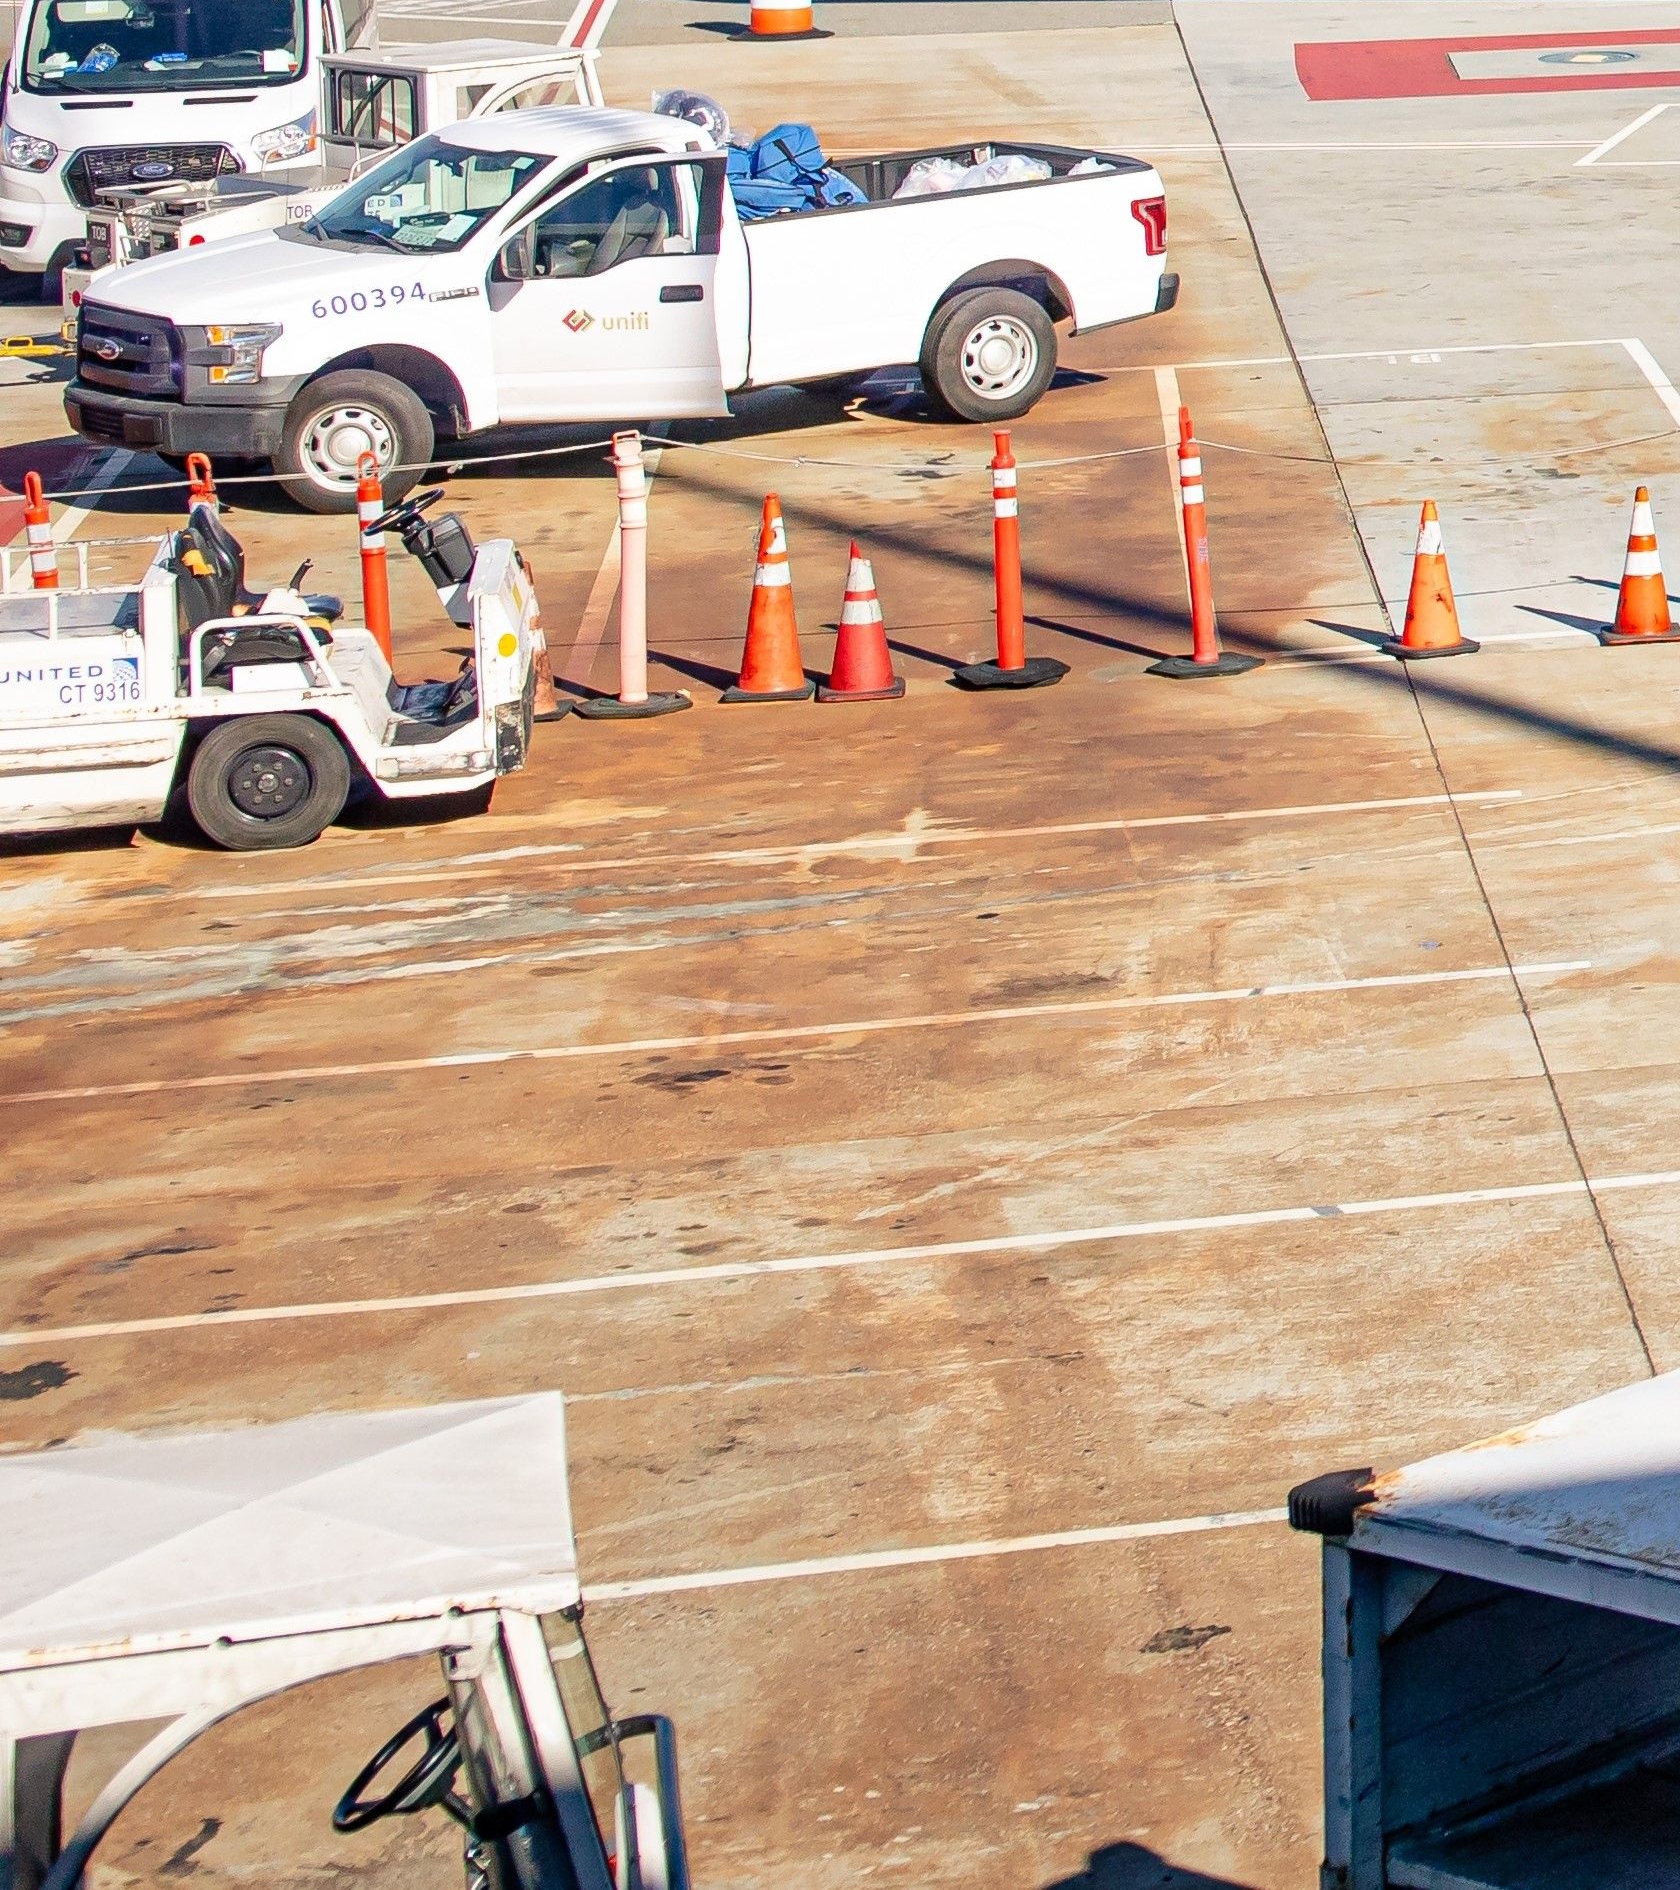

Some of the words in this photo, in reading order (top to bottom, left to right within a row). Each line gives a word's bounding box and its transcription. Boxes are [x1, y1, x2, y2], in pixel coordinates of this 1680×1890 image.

[312, 281, 427, 319] 600394
[602, 311, 650, 331] unifi
[0, 665, 104, 684] UNITED
[59, 684, 87, 704] CT
[93, 681, 140, 703] 9316
